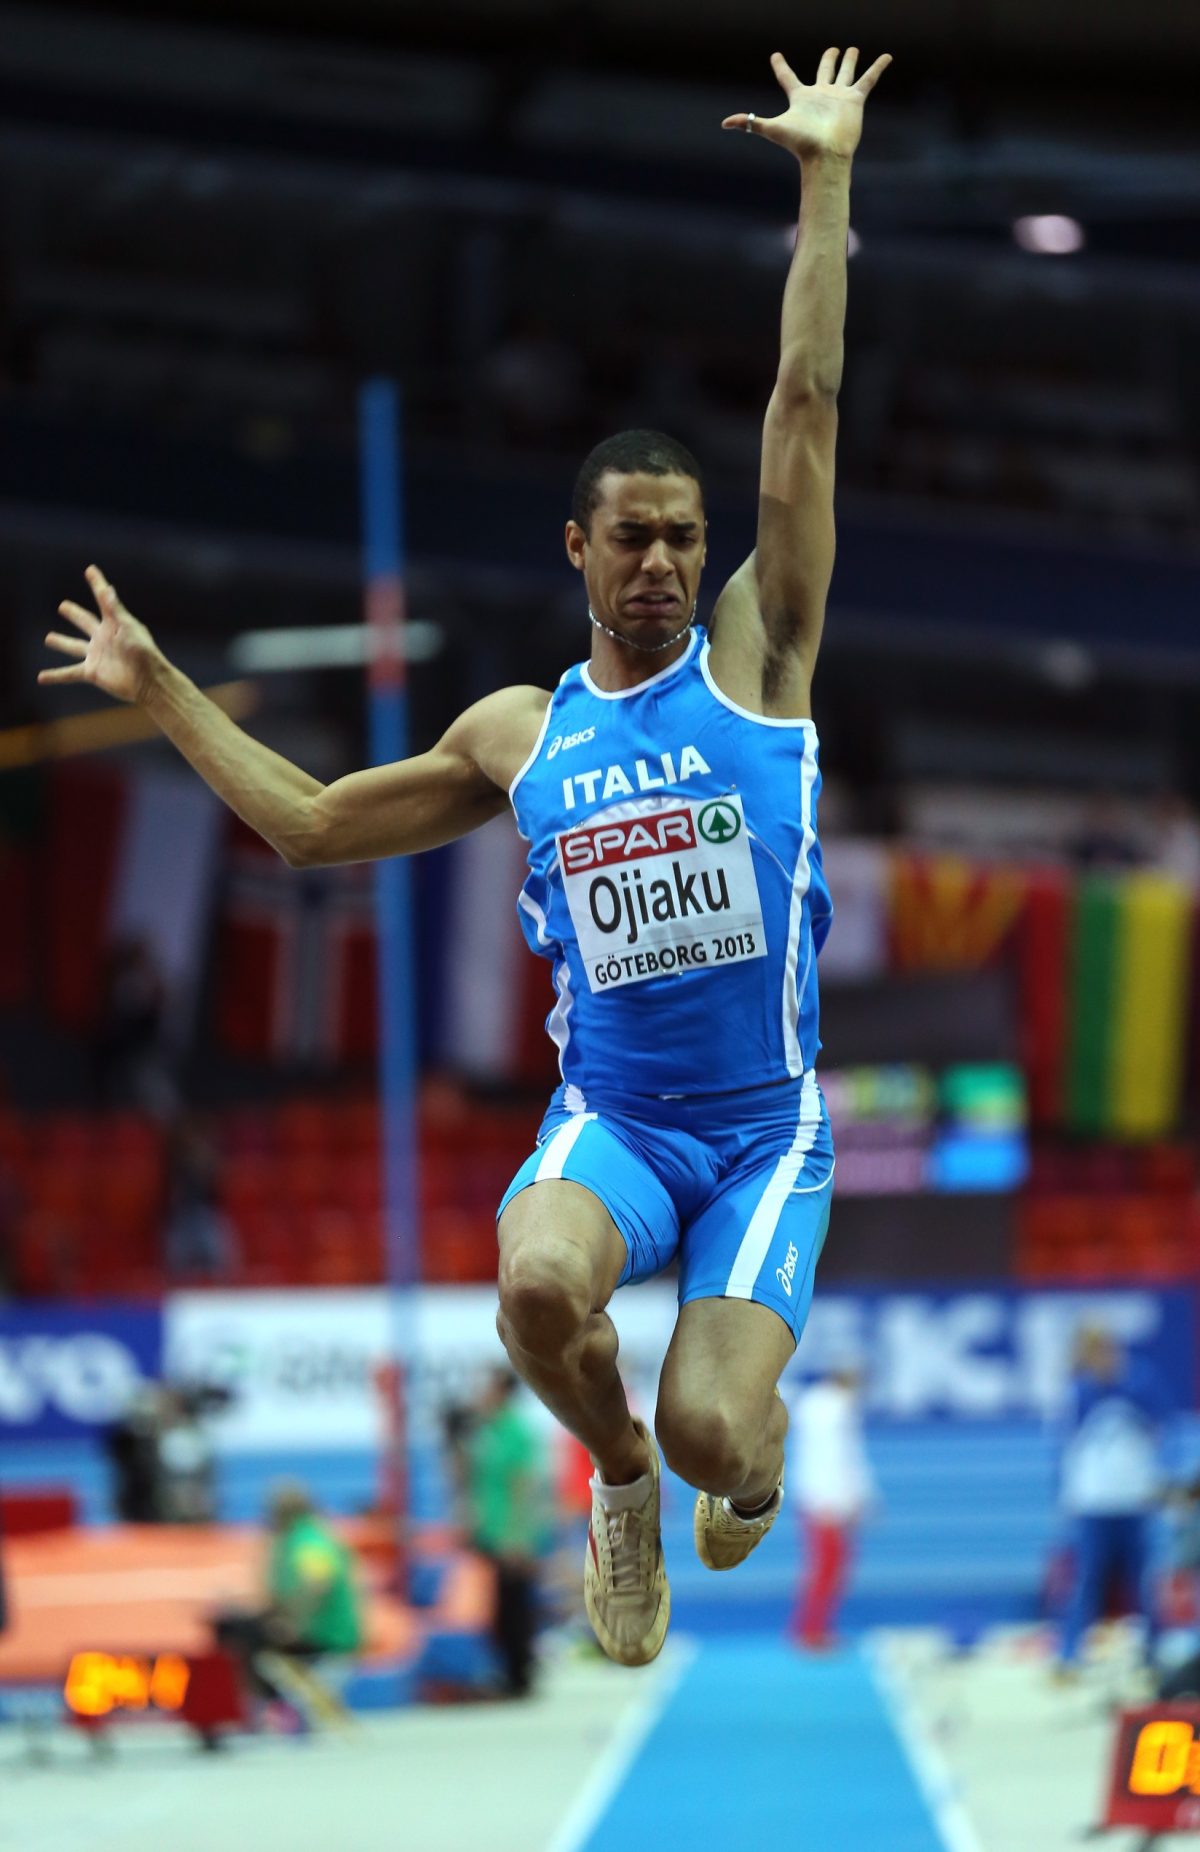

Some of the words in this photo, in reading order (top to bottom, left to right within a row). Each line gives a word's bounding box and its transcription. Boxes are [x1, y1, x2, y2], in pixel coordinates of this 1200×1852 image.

[562, 745, 712, 810] ITALIA
[565, 816, 692, 870] SPAR
[589, 861, 731, 944] Ojiaku
[594, 941, 707, 985] GÖTEBORG
[711, 933, 756, 960] 2013
